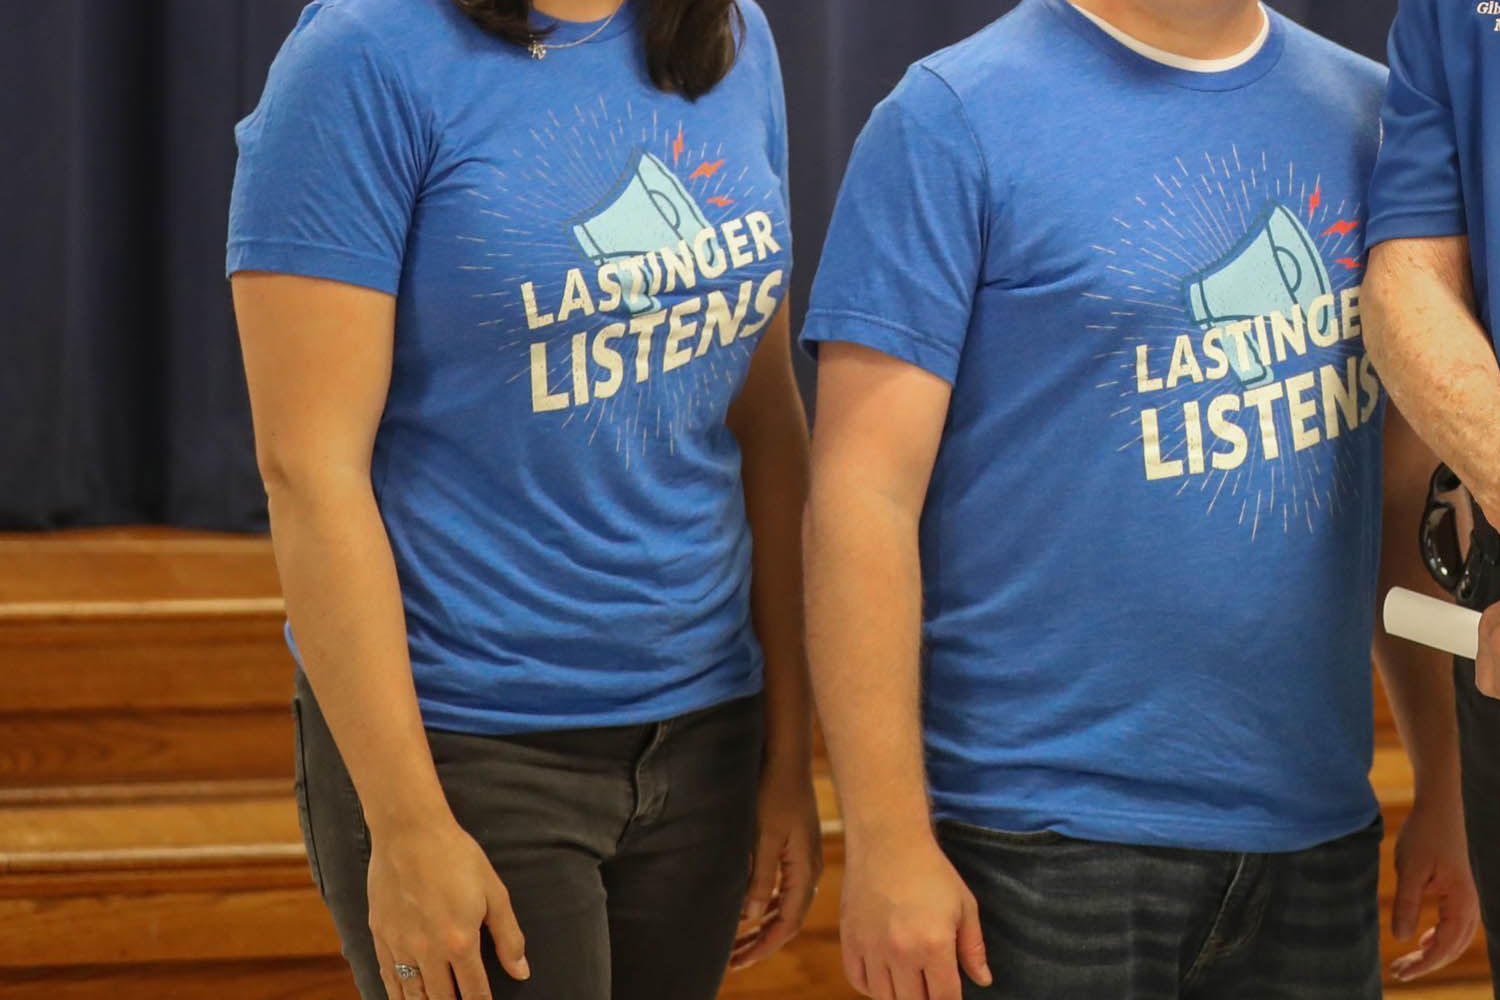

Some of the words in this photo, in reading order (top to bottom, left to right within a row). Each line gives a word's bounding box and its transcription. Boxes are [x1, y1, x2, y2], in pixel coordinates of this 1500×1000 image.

[520, 211, 782, 331] LASTINGER
[529, 268, 784, 413] LISTENS
[1135, 286, 1362, 393] LASTINGE
[1140, 351, 1380, 481] LISTENS
